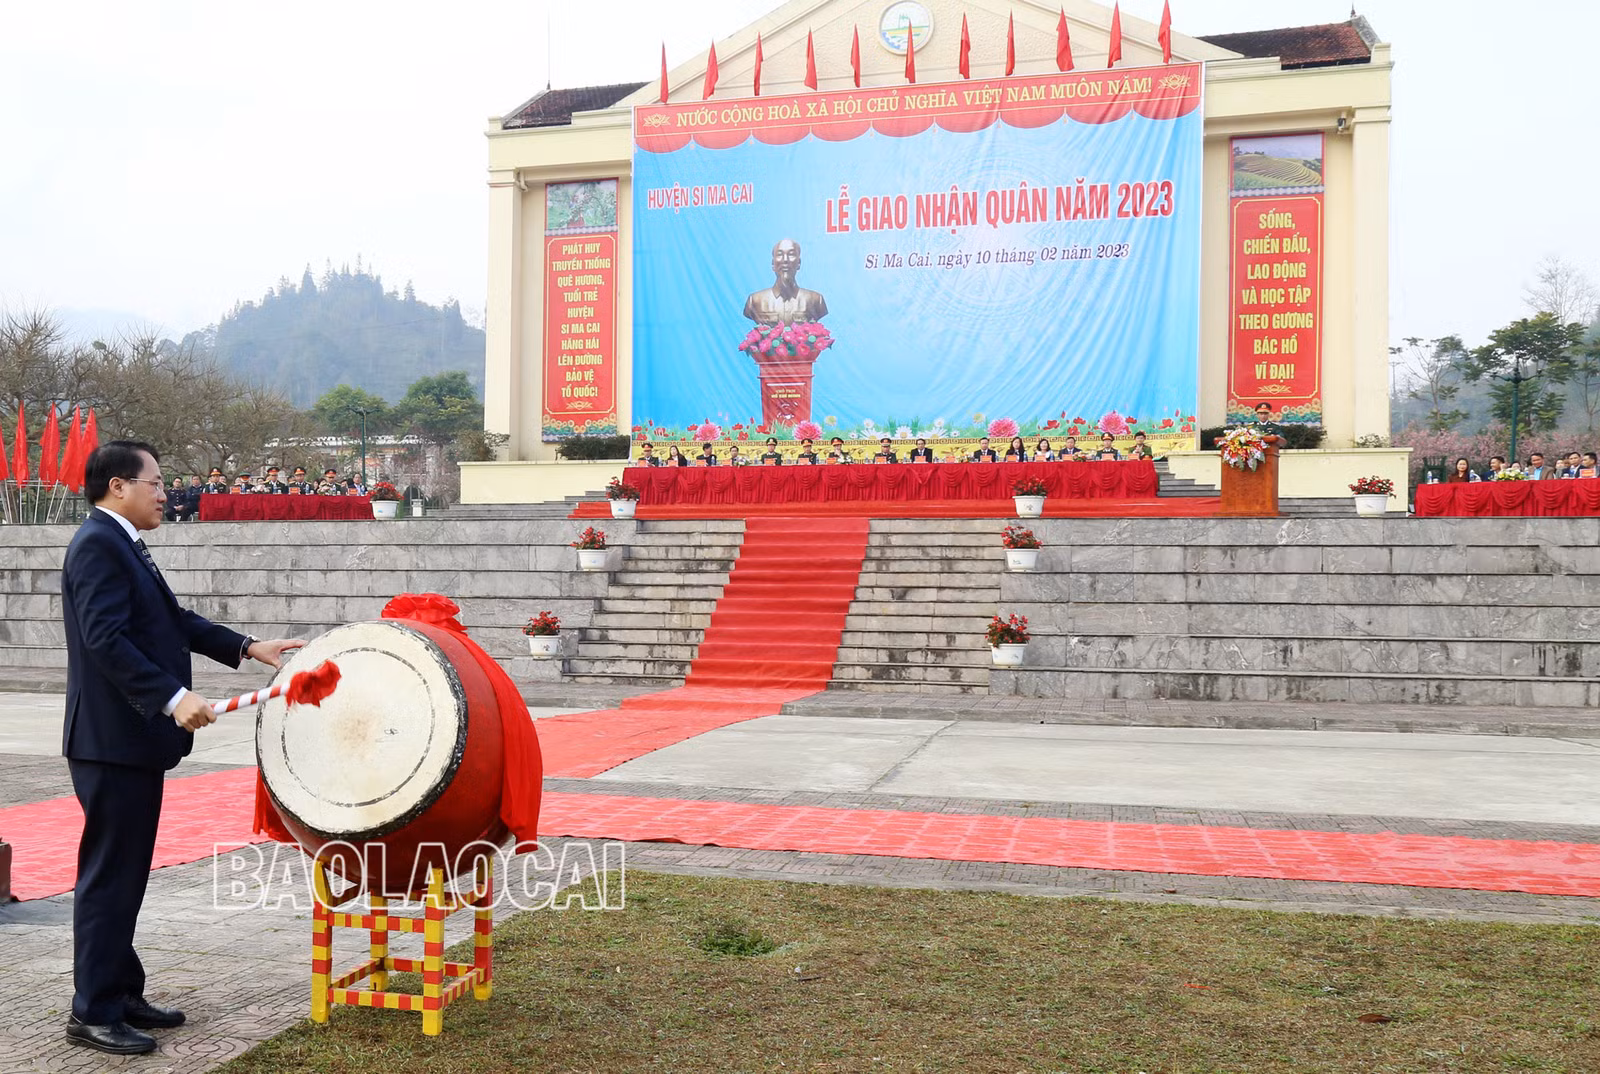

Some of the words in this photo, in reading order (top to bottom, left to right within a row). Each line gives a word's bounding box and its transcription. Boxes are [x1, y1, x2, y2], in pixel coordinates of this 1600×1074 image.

[676, 107, 718, 127] NƯỚC
[721, 104, 764, 126] CỘNG
[767, 100, 801, 120] HOÀ
[806, 98, 829, 118] XÃ
[833, 96, 862, 118] HỘI
[867, 90, 900, 113] CHỦ
[904, 90, 958, 110] NGHĨA
[963, 84, 1003, 108] VIỆT
[1007, 85, 1046, 102] NAM
[1050, 77, 1103, 100] MUÔN
[1107, 75, 1152, 95] NĂM!
[648, 182, 689, 214] HUYỆN
[692, 185, 704, 207] SI
[707, 184, 728, 207] MA
[731, 182, 753, 205] CAI
[826, 184, 850, 233] LỄ
[857, 194, 908, 232] GIAO
[916, 185, 978, 234] NHẬN
[985, 181, 1048, 228] QUÂN
[1056, 177, 1109, 221] NĂM
[1116, 180, 1175, 219] 2023
[1259, 208, 1296, 230] SỐNG,
[562, 242, 583, 255] PHÁT
[584, 242, 601, 254] HUY
[1243, 234, 1280, 254] CHIẾN
[1283, 232, 1311, 254] ĐẤU,
[584, 256, 611, 270] THỐNG
[865, 254, 878, 269] Si
[883, 254, 903, 268] Ma
[908, 252, 932, 268] Cai,
[938, 250, 972, 269] ngày
[976, 250, 991, 264] 10
[995, 247, 1035, 265] tháng
[1040, 247, 1058, 261] 02
[1061, 244, 1092, 260] năm
[1096, 243, 1129, 259] 2023
[1247, 264, 1270, 280] LAO
[1273, 260, 1307, 282] ĐỘNG
[558, 274, 573, 288] QUÊ
[583, 286, 598, 302] TRẺ
[1242, 286, 1258, 305] VÀ
[1260, 289, 1285, 307] HỌC
[1288, 285, 1311, 307] TẬP
[567, 305, 594, 319] HUYỆN
[1239, 314, 1269, 330] THEO
[1272, 312, 1313, 329] GƯƠNG
[561, 323, 569, 334] SI
[571, 323, 584, 334] MA
[586, 322, 600, 333] CAI
[561, 338, 584, 350] HĂNG
[585, 336, 600, 349] HÁI
[1254, 336, 1278, 355] BÁC
[1281, 333, 1298, 354] HỒ
[558, 354, 573, 366] LÊN
[566, 367, 582, 381] BẢO
[584, 368, 594, 383] VỆ
[1255, 362, 1267, 380] VĨ
[1269, 363, 1295, 382] ĐẠI!
[573, 383, 598, 398] QUỐC!
